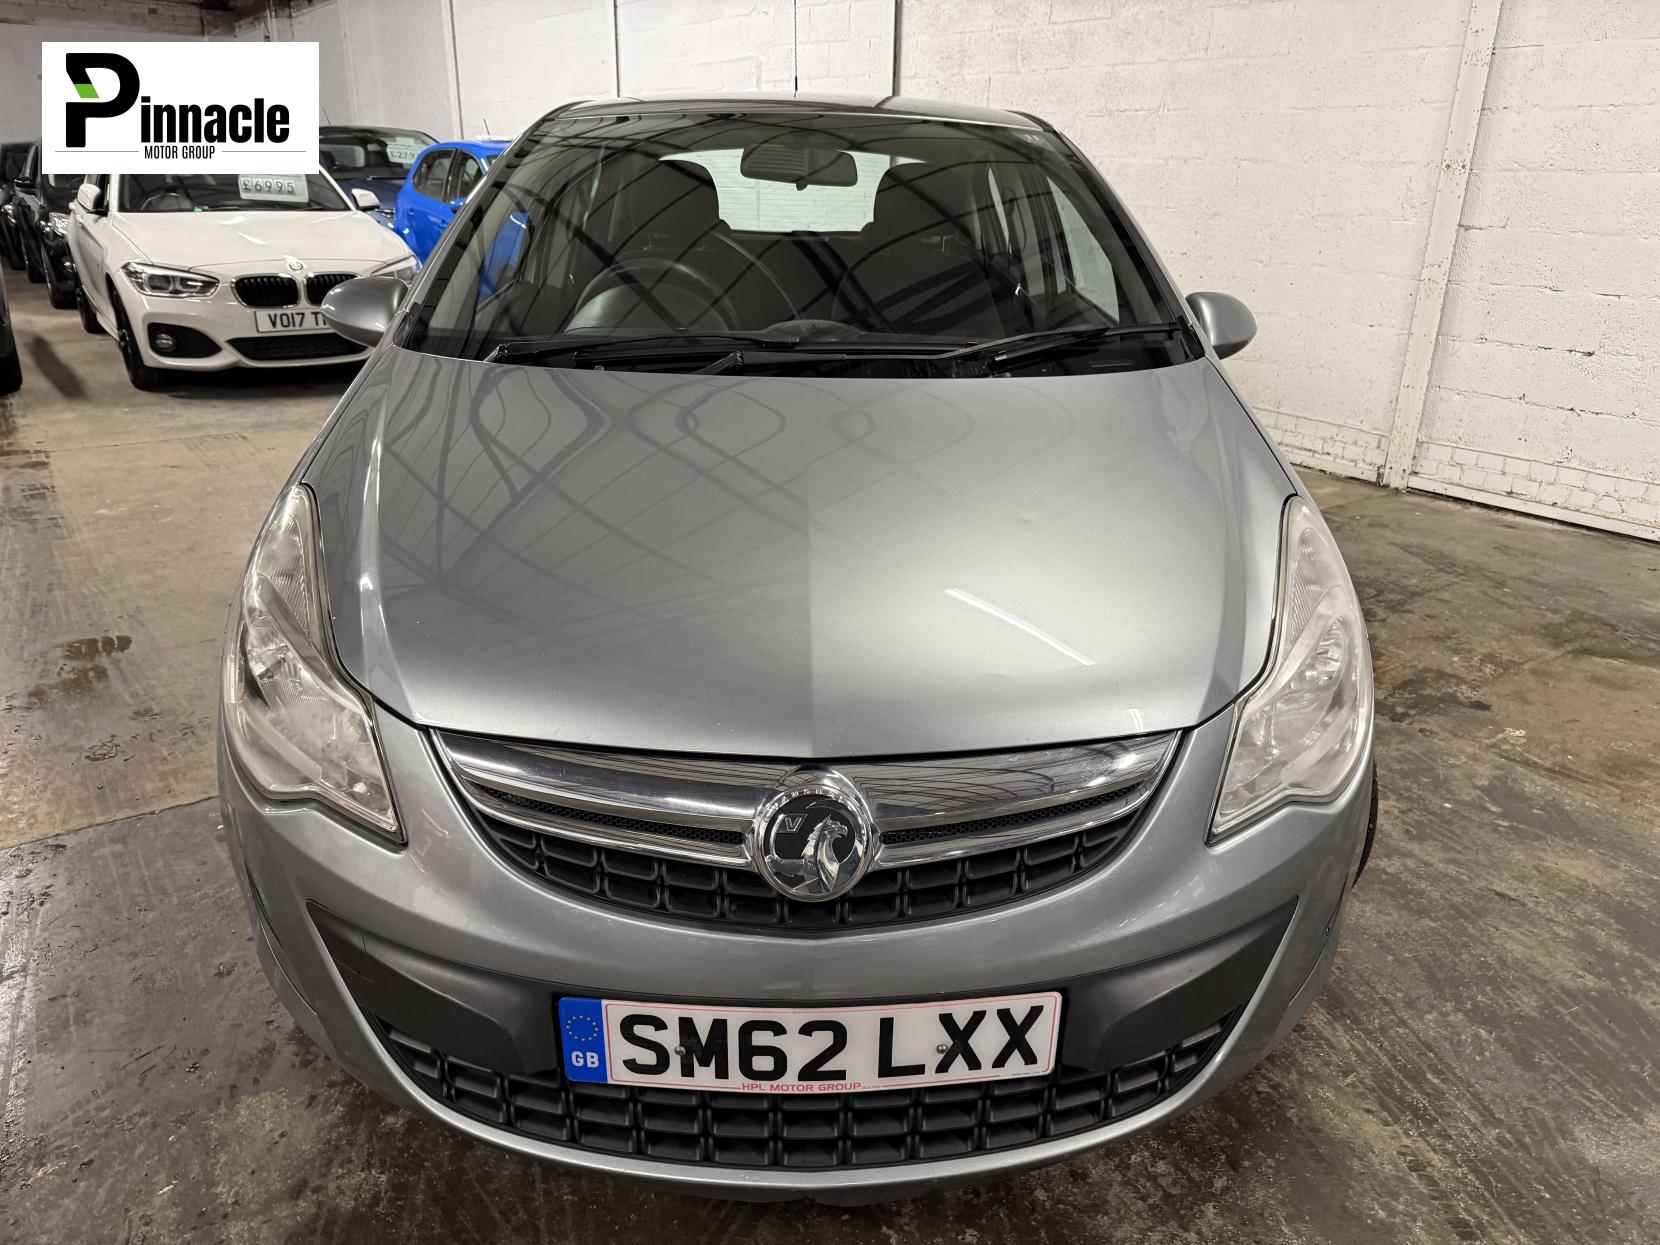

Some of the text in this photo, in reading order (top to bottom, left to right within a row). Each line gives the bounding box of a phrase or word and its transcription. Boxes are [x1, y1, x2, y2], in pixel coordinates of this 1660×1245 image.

[243, 179, 296, 194] £6995
[620, 1004, 1044, 1082] SM62 LXX
[571, 1051, 600, 1068] GB
[742, 1083, 765, 1091] HPL
[769, 1084, 813, 1092] MOTOR
[818, 1082, 861, 1091] GROUP
